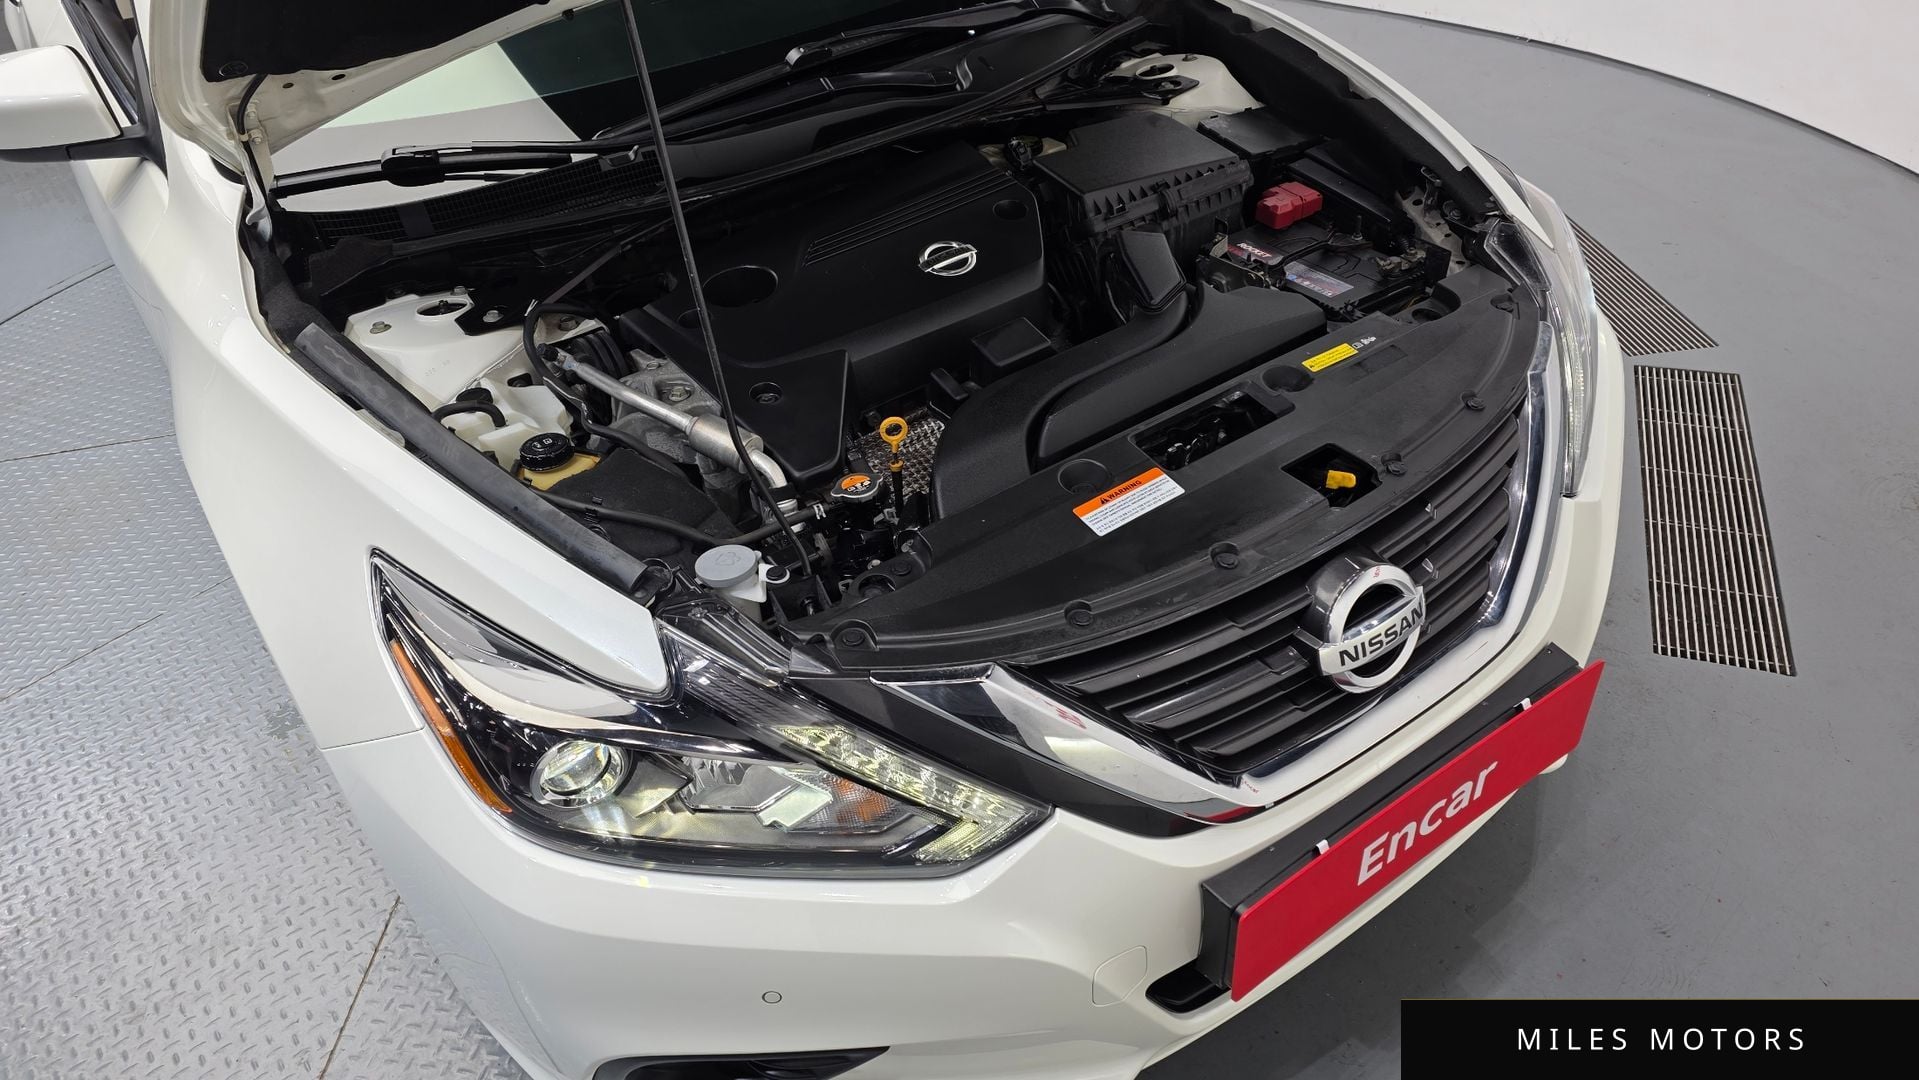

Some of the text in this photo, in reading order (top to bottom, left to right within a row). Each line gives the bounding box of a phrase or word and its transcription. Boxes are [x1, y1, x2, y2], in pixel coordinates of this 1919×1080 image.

[1108, 480, 1142, 501] WARNING
[1338, 606, 1423, 667] NISSAN
[1357, 760, 1498, 886] Encar
